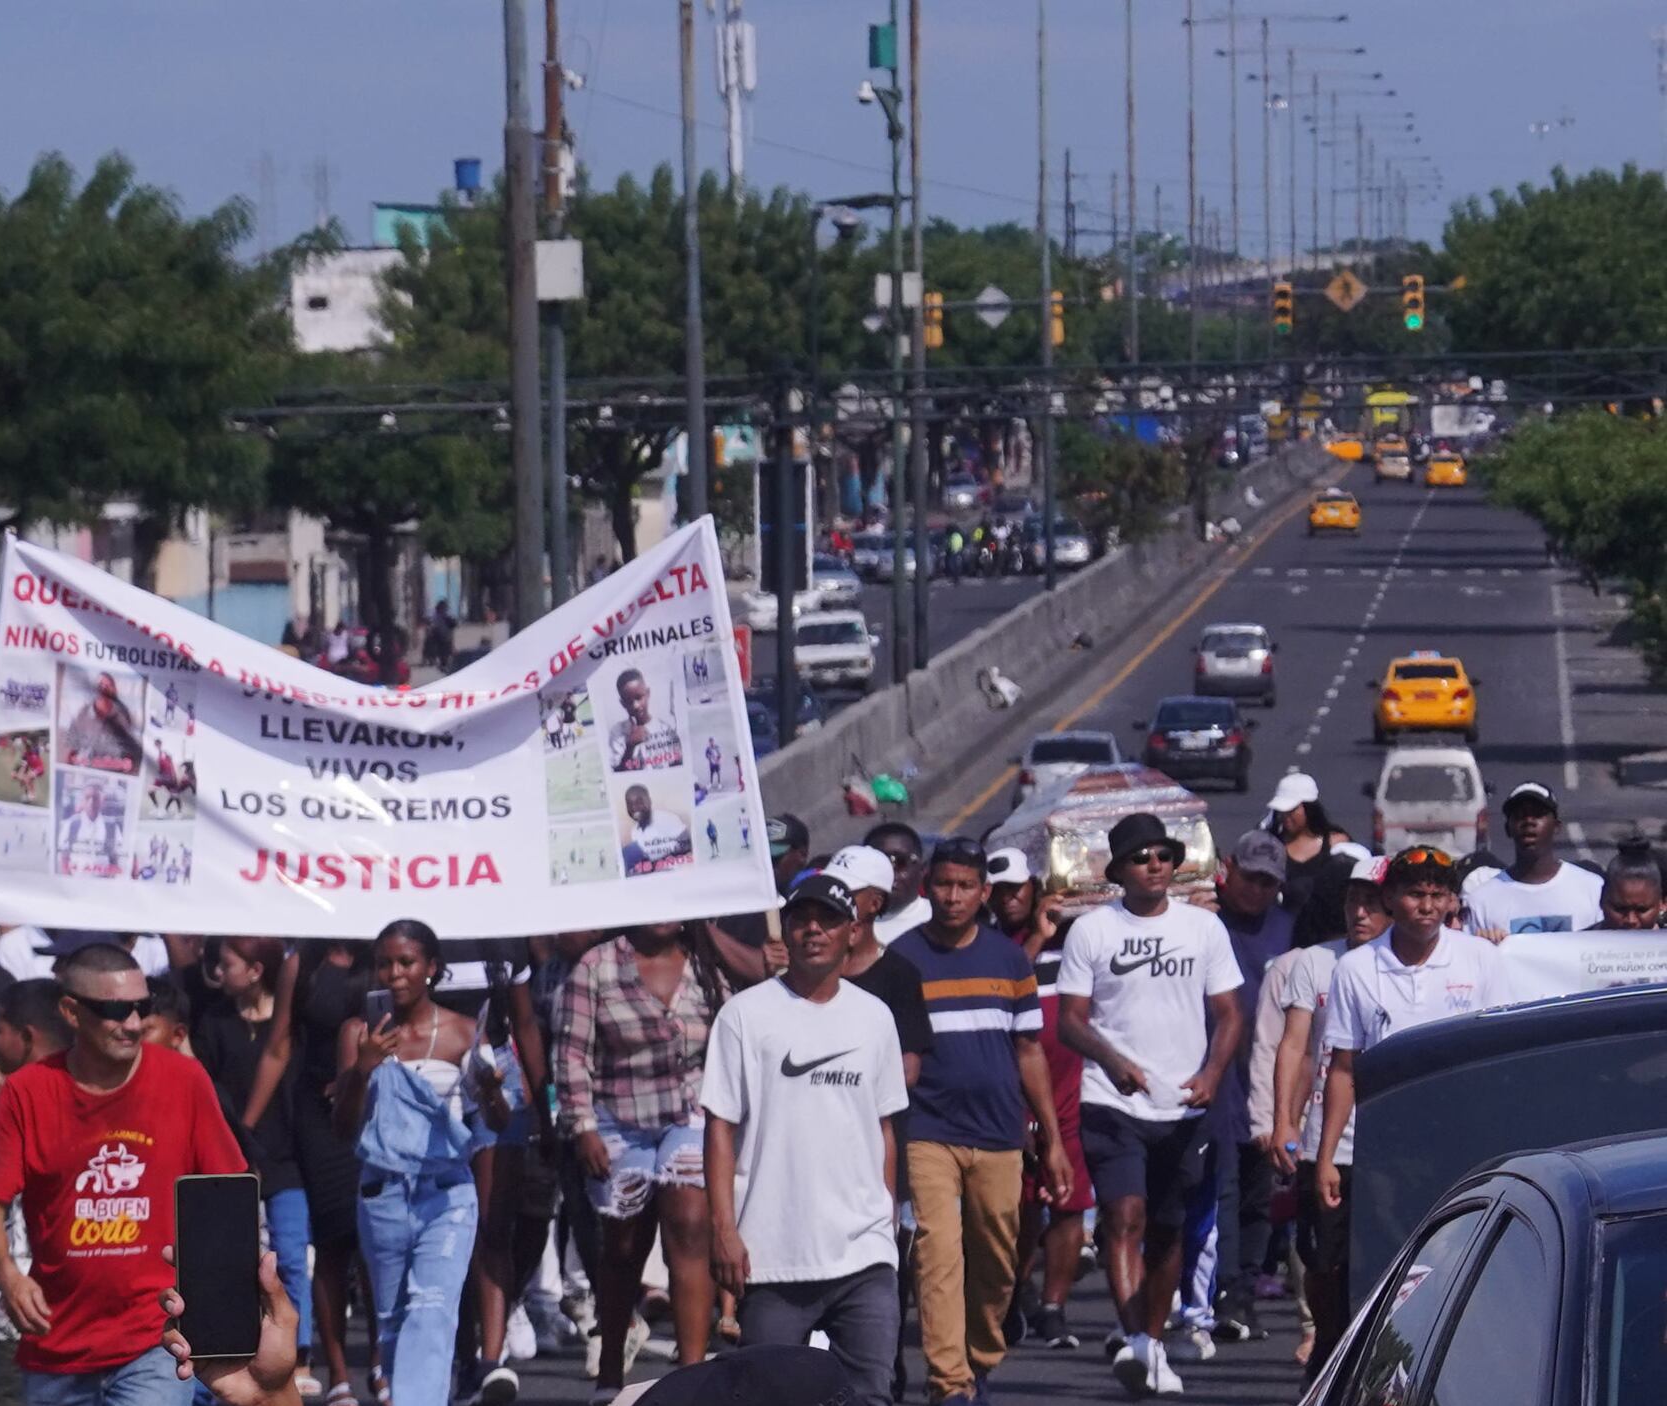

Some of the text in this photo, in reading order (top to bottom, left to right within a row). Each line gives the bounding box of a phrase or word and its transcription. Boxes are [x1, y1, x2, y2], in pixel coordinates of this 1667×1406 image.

[587, 616, 715, 661] CRIMINALES
[305, 756, 419, 784] VIVOS
[220, 788, 288, 817] LOS
[238, 847, 503, 891] JUSTICIA
[1119, 936, 1165, 958] JUST
[95, 1197, 150, 1221] BUEN
